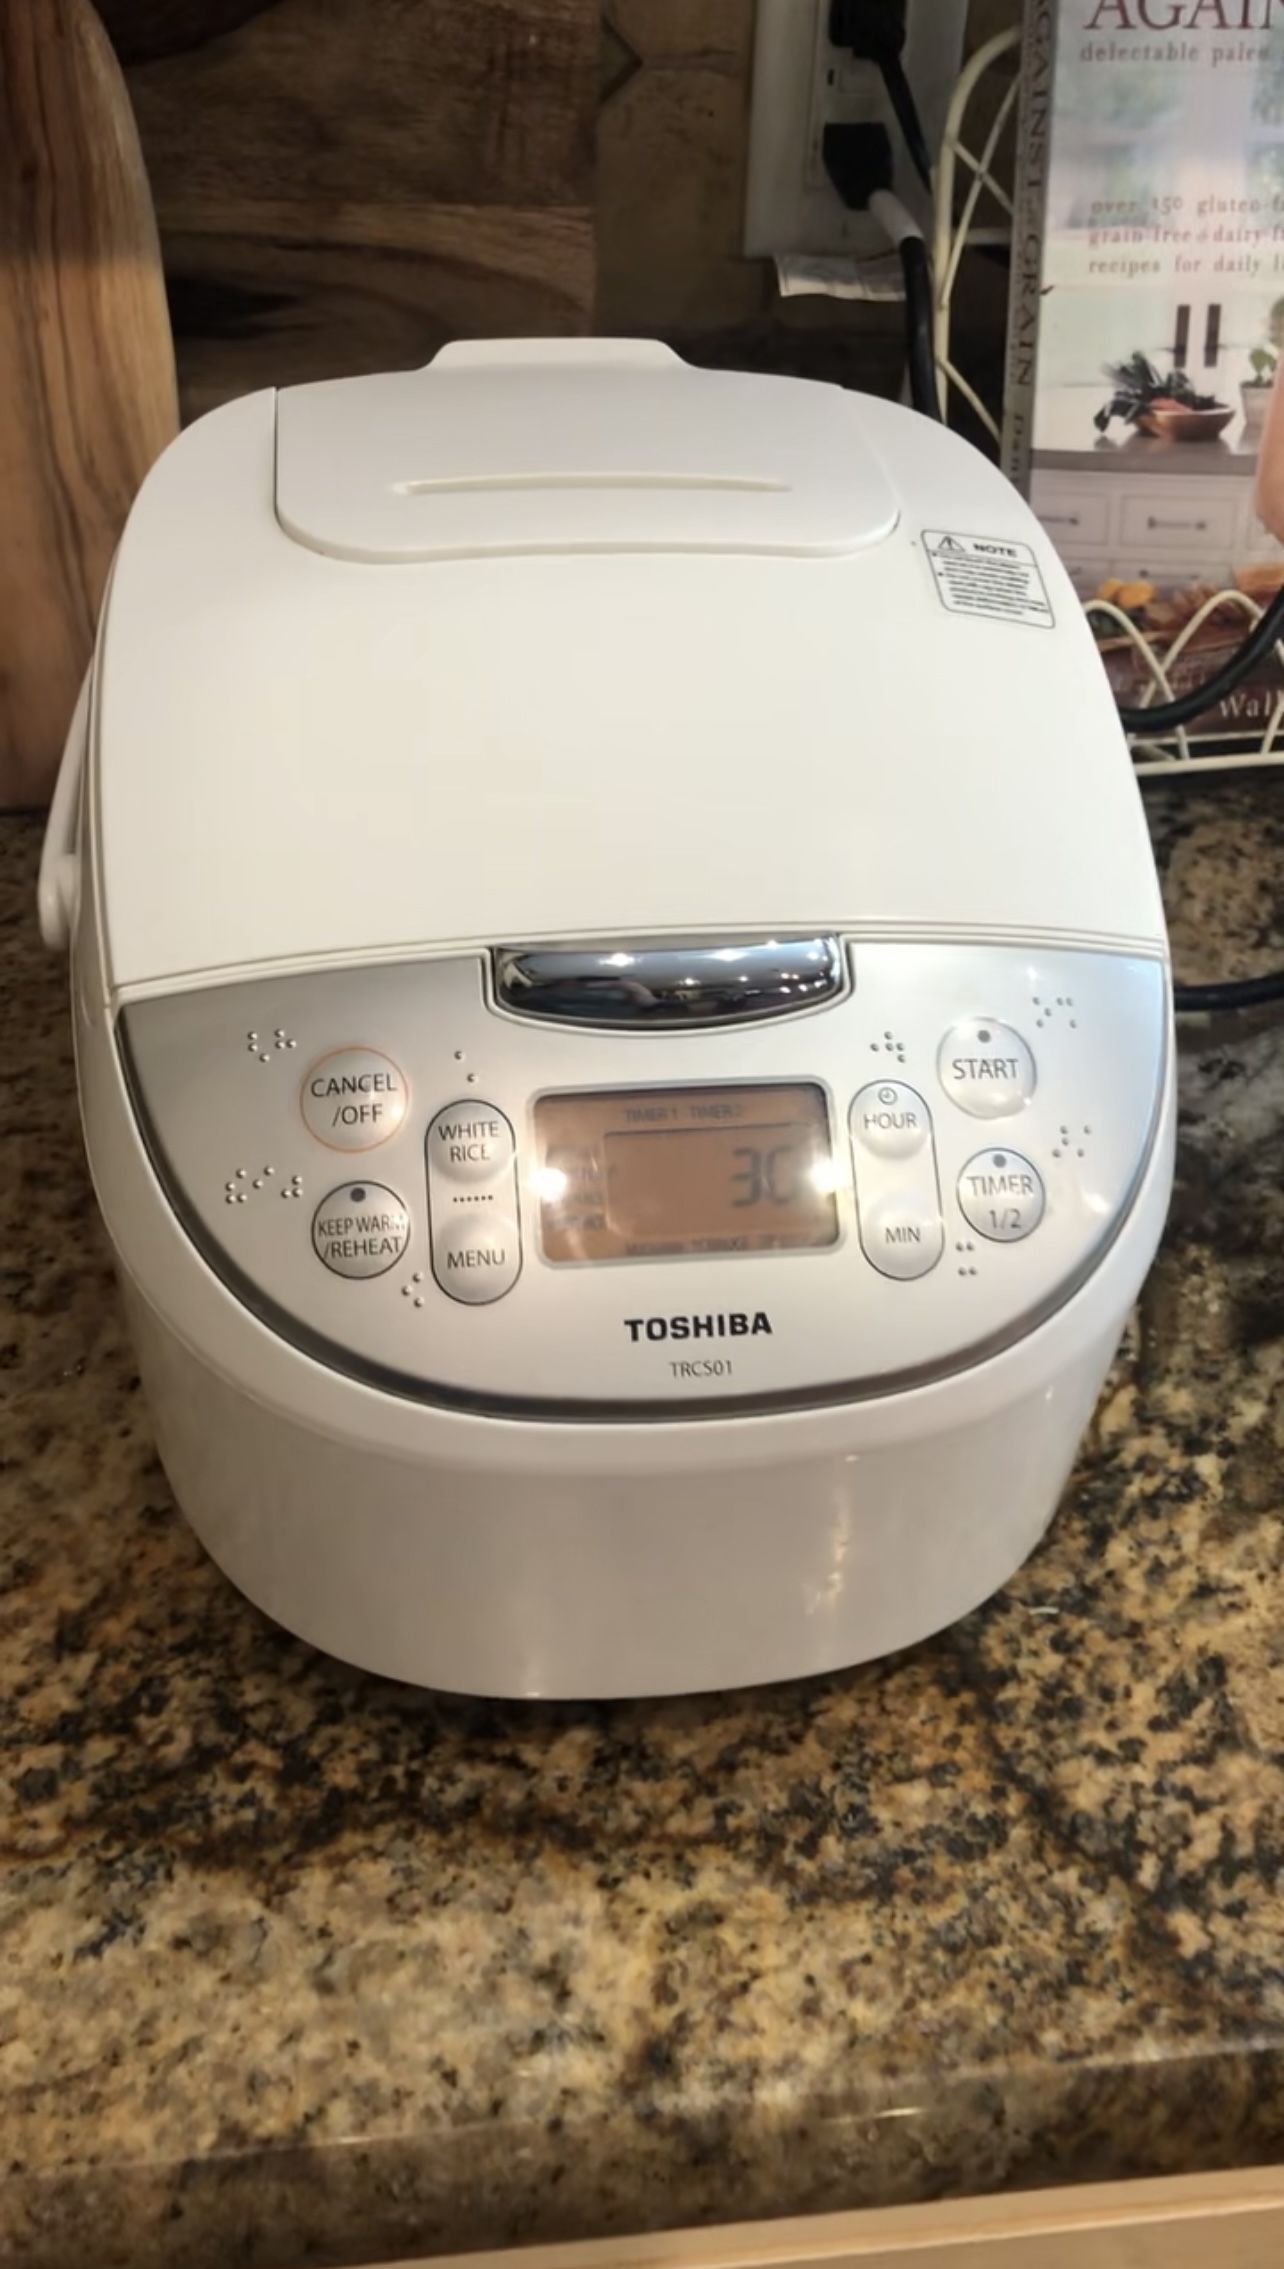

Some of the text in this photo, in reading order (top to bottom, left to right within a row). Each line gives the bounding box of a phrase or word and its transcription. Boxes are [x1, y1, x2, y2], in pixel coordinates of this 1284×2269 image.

[1080, 41, 1271, 68] delectable paleo
[1026, 0, 1052, 195] GAINST
[1090, 200, 1137, 214] over
[1152, 195, 1184, 216] 150
[1089, 257, 1160, 278] recipes
[1174, 255, 1202, 273] for
[1213, 254, 1259, 277] daily
[952, 1058, 1019, 1080] START
[310, 1073, 398, 1098] CANCEL
[332, 1103, 383, 1127] /OFF
[864, 1113, 917, 1129] HOUR
[438, 1120, 500, 1141] WHITE
[450, 1143, 490, 1163] RICE
[967, 1174, 1034, 1197] TIMER
[317, 1217, 354, 1238] KEEP
[989, 1208, 1022, 1229] 1/2
[885, 1226, 921, 1244] MIN
[323, 1235, 402, 1259] /REHEAT
[447, 1249, 506, 1269] MENU
[624, 1311, 773, 1343] TOSHIBA
[669, 1359, 732, 1378] TRCS01
